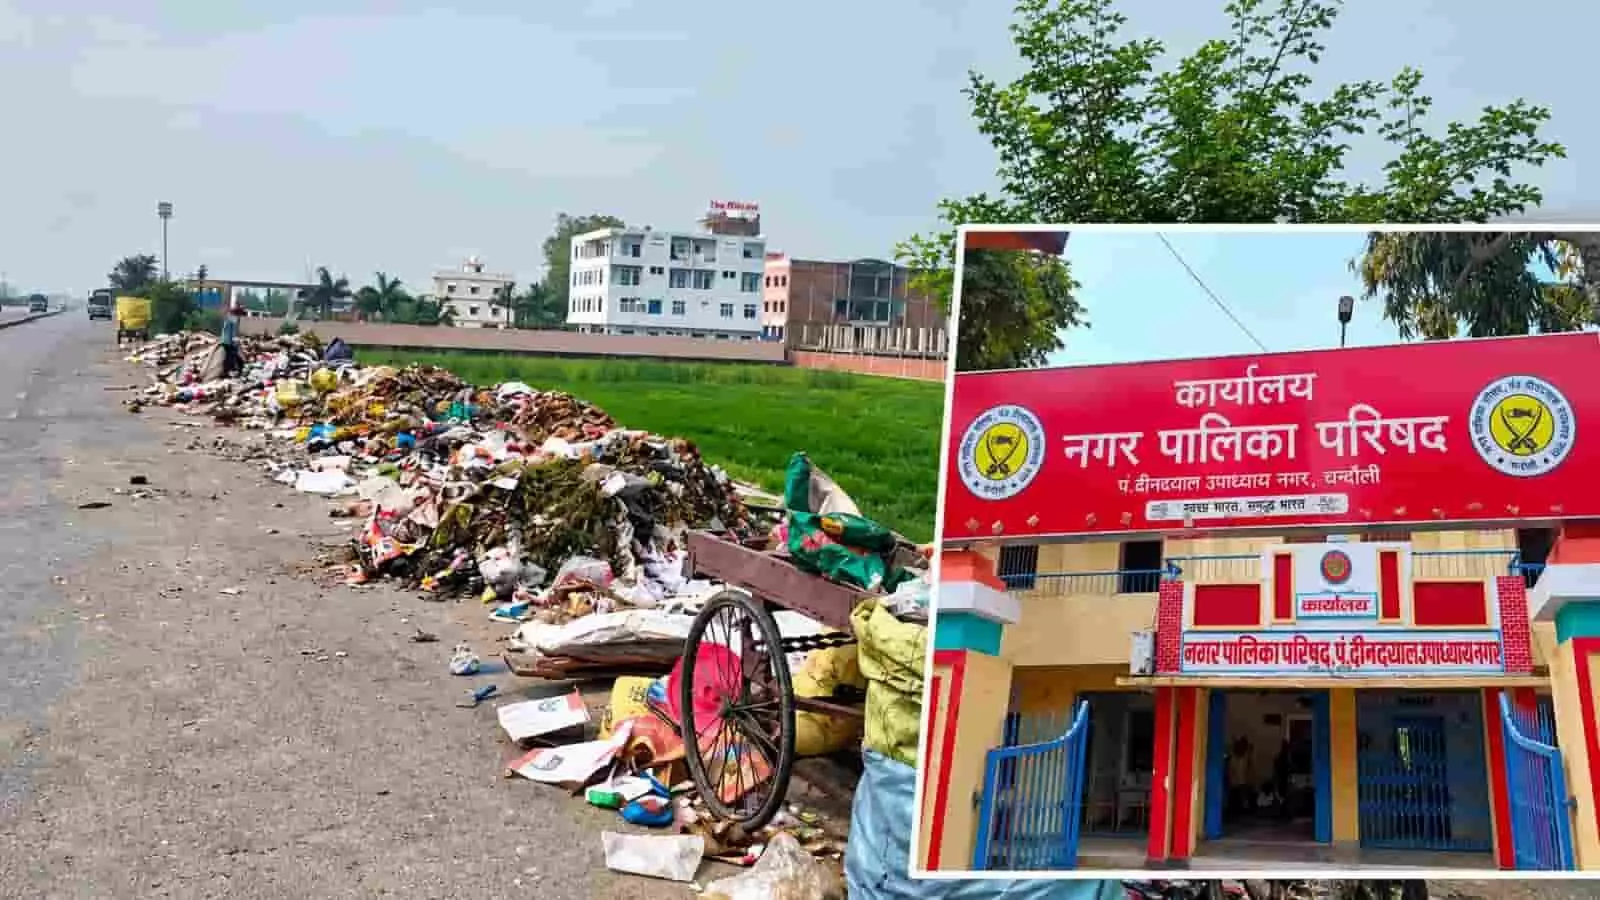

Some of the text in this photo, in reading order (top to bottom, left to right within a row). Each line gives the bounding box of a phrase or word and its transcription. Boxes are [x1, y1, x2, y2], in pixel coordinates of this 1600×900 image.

[1174, 364, 1318, 408] कार्यालय
[1062, 431, 1145, 469] नगर
[1157, 412, 1299, 465] पालिका
[1315, 403, 1450, 458] परिषद
[1206, 473, 1273, 491] उपाध्याय
[1322, 464, 1380, 485] चन्दौली
[1280, 499, 1305, 511] भारत
[1303, 593, 1369, 612] कार्यालय
[1184, 641, 1220, 664] नगर
[1222, 635, 1278, 664] पालिका
